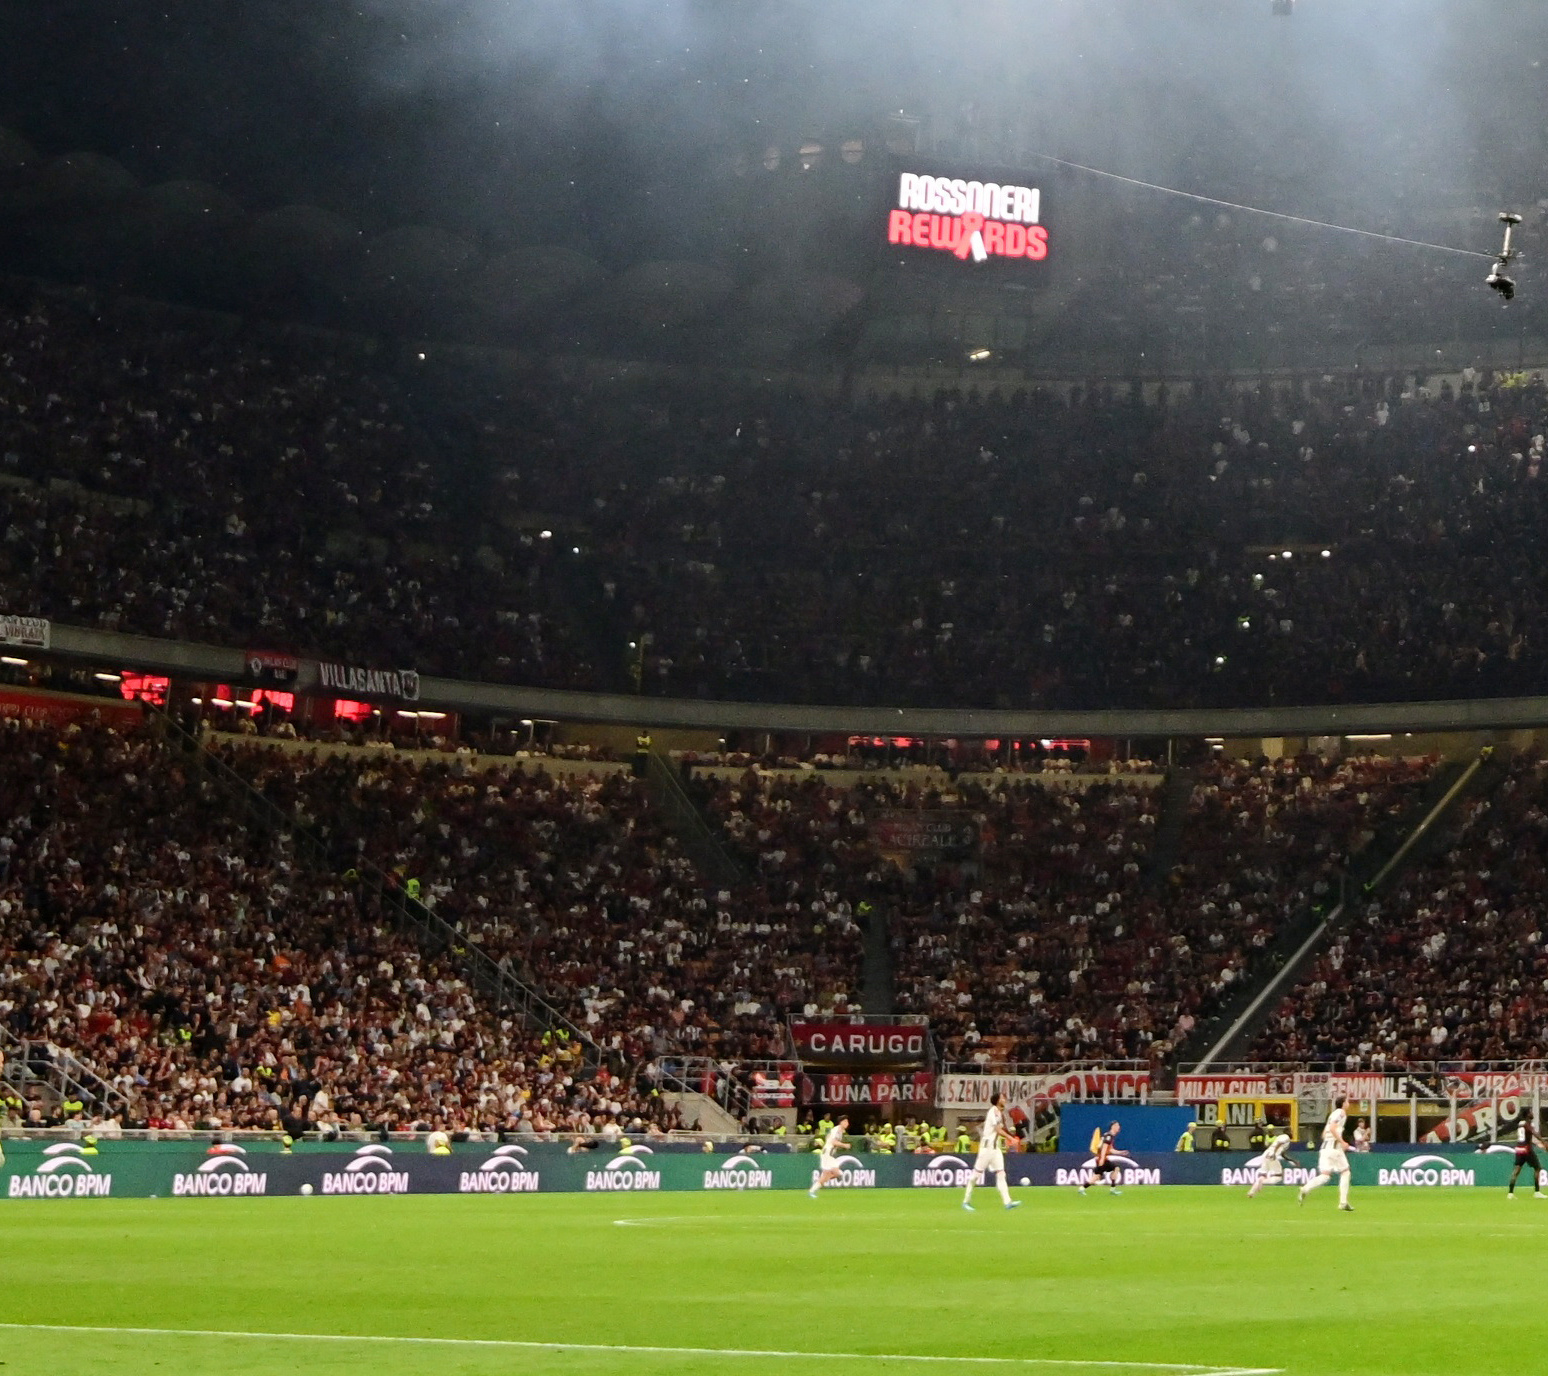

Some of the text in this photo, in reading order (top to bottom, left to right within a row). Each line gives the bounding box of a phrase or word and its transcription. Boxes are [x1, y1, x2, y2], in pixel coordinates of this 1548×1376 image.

[899, 171, 1040, 223] ROSSONERI
[319, 661, 402, 696] VILLASANTA
[810, 1033, 923, 1054] CARUGO
[819, 1083, 872, 1102] LUNA
[876, 1082, 929, 1100] PARK
[1179, 1080, 1225, 1098] MILAN
[1228, 1080, 1266, 1096] CLUB
[1330, 1076, 1408, 1099] FEMMINILE
[9, 1174, 112, 1197] BANCO BPM
[172, 1173, 267, 1195] BANCO BPM
[322, 1172, 409, 1193] BANCO BPM
[460, 1171, 539, 1192] BANCO BPM
[586, 1171, 660, 1190] BANCO BPM
[704, 1170, 773, 1188] BANCO BPM
[853, 1169, 876, 1187] BPM
[913, 1169, 953, 1186] BANCO
[1124, 1168, 1161, 1185] BPM
[1378, 1168, 1475, 1186] BANCO BPM
